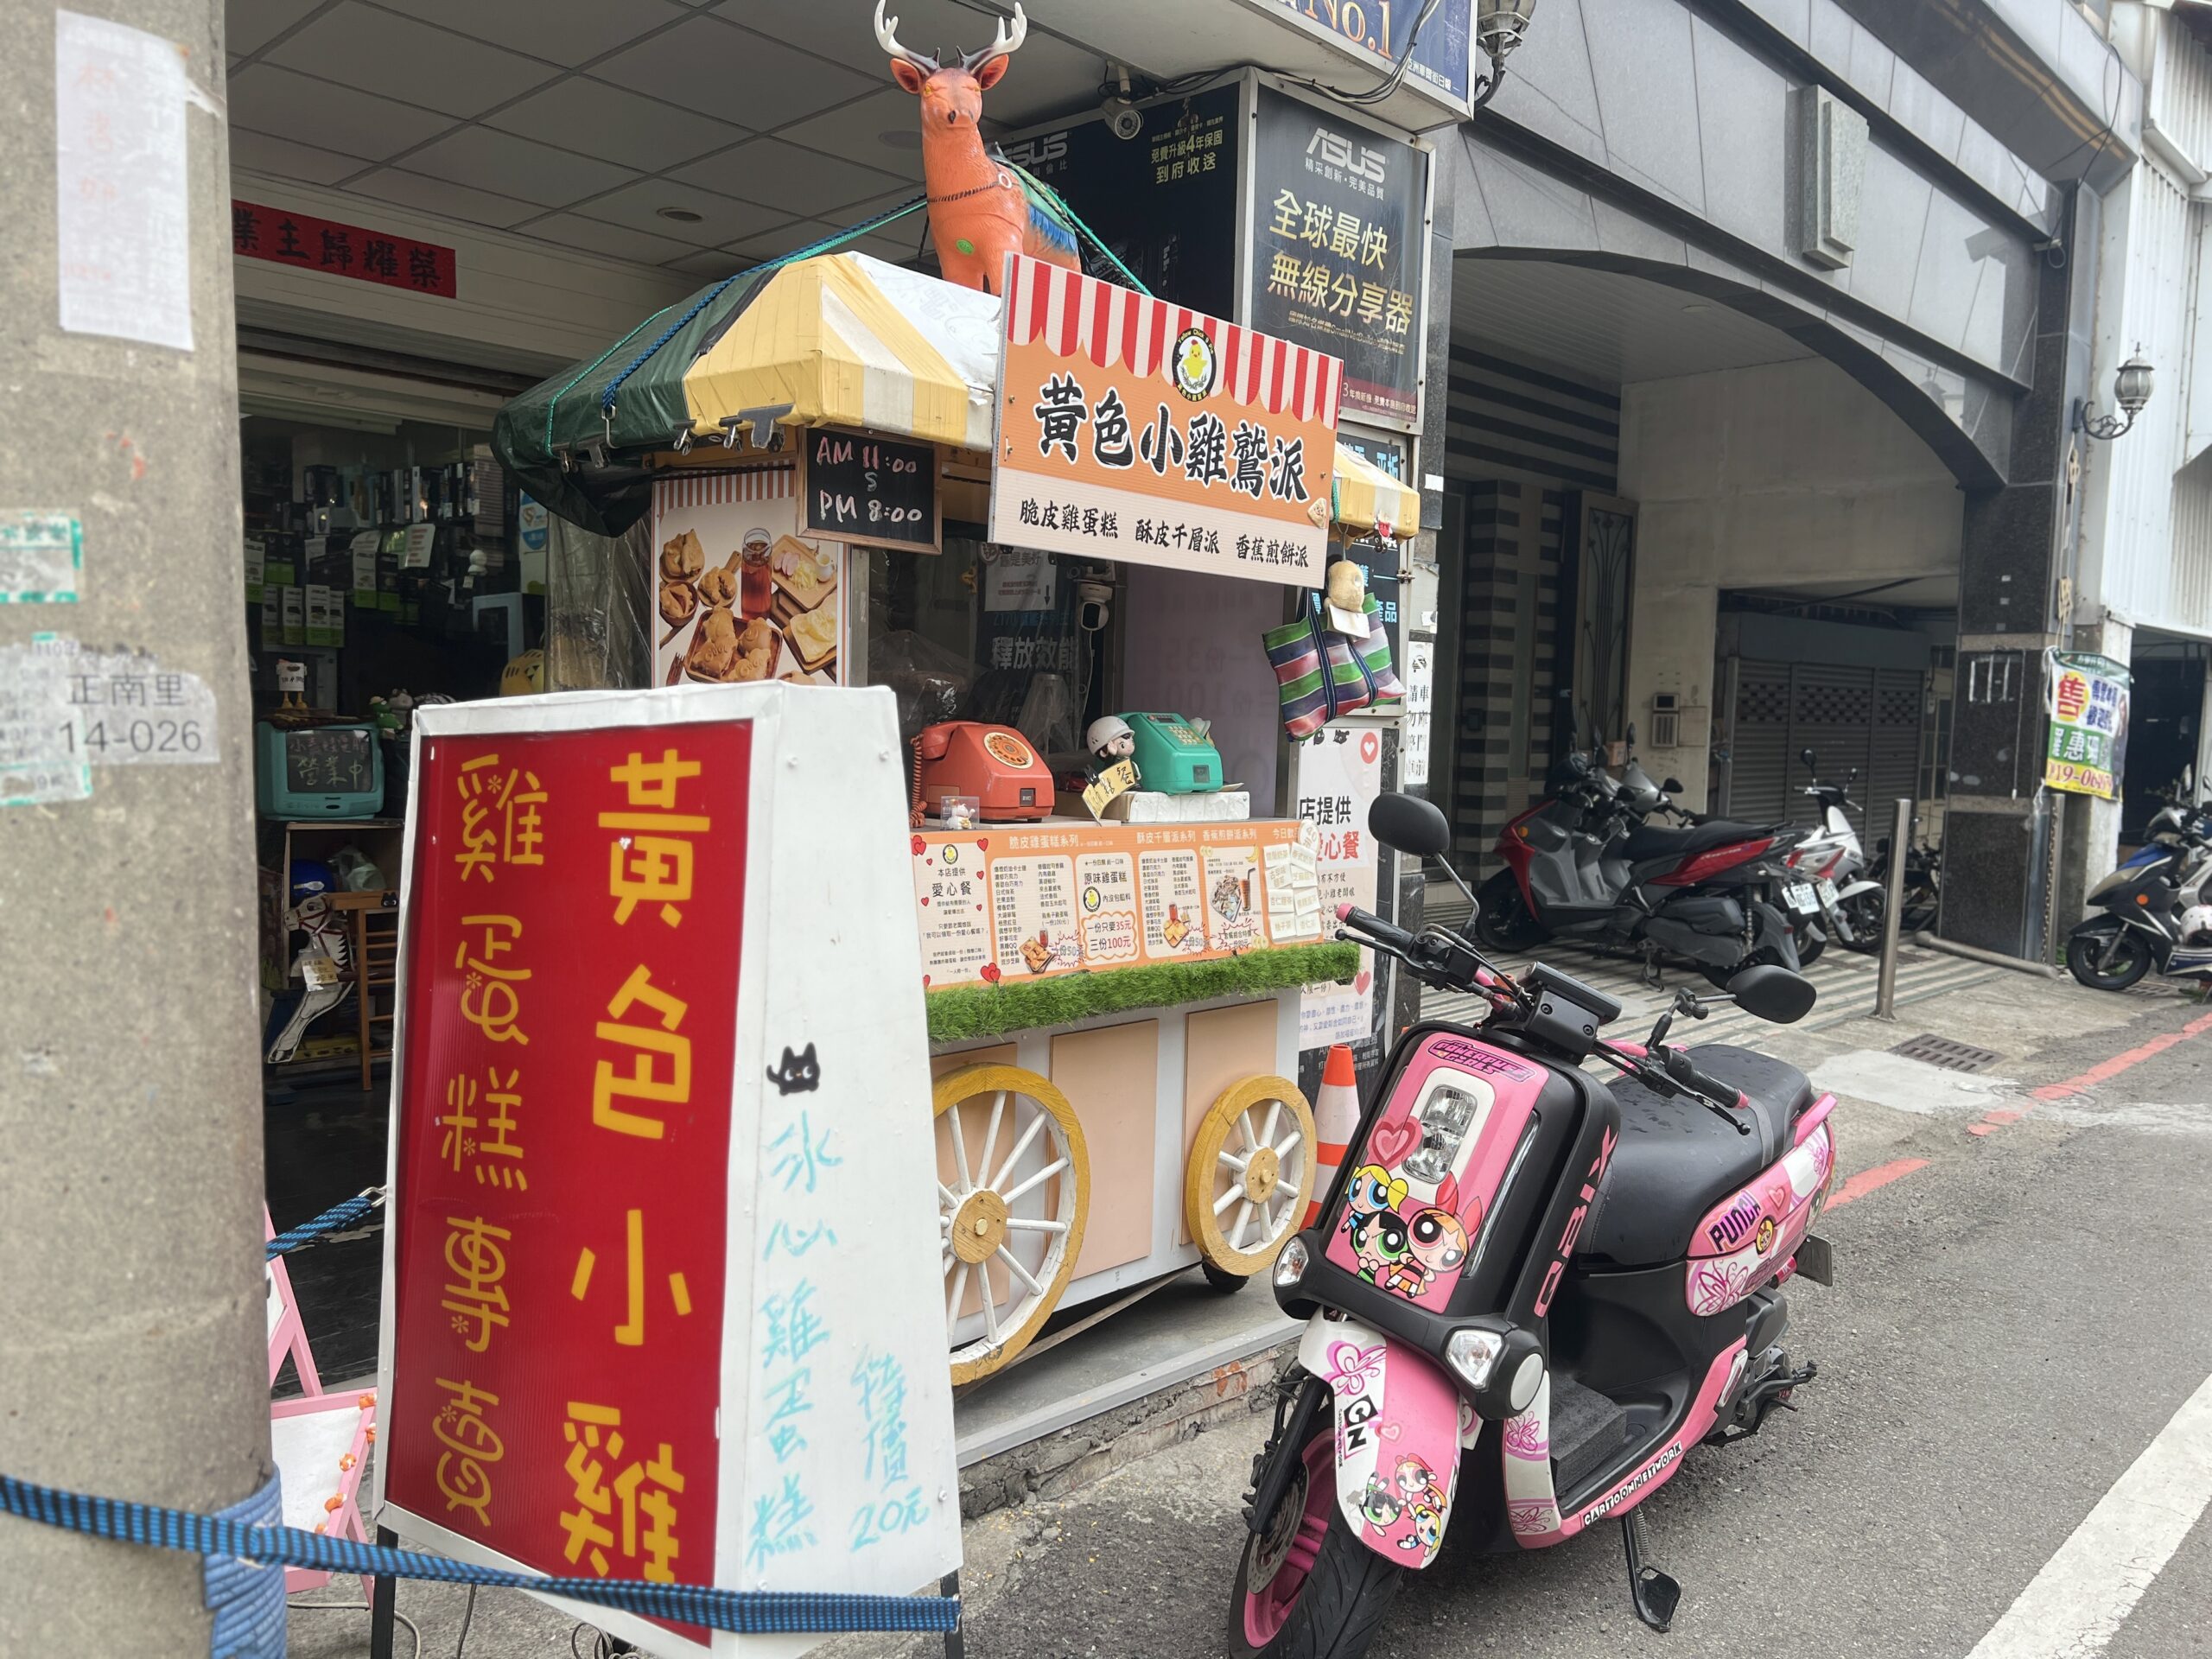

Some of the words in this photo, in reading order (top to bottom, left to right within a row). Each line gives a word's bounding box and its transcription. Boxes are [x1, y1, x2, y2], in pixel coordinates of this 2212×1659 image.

[1003, 131, 1068, 168] SUS
[1151, 129, 1224, 164] 免費升級4年保固
[1306, 127, 1386, 184] ASUS
[1155, 151, 1217, 185] 到府收送
[1268, 188, 1389, 270] 全球最快
[1267, 250, 1414, 336] 無線分享器
[817, 435, 855, 467] AM
[862, 444, 918, 474] 11:00
[1036, 373, 1309, 502] 黃色小雞鷲派
[819, 489, 858, 524] PM
[868, 499, 923, 523] 8:00
[1020, 498, 1119, 539] 脆皮雞蛋糕
[1135, 518, 1221, 555] 酥皮千層派
[1235, 533, 1310, 569] 香蕉煎餅派
[992, 635, 1077, 671] 釋放效能
[66, 673, 187, 708] 正南里
[58, 719, 203, 754] 14-026
[1008, 834, 1079, 849] 脆皮雞蛋糕系列
[1135, 830, 1196, 844] 酥皮千層派系列
[1202, 828, 1257, 842] 香蕉煎餅派系列
[931, 881, 972, 898] 愛心餐
[938, 868, 966, 878] 本店提供
[1084, 870, 1128, 886] 原味雞蛋糕
[1318, 873, 1346, 886] 有不方便
[1087, 919, 1132, 934] 一份只要35元
[1090, 936, 1132, 951] 三份100元
[558, 748, 711, 1584] 黃色小雞
[1708, 1190, 1761, 1252] PUNCH
[850, 1344, 910, 1493] 特價
[1346, 1398, 1374, 1453] CN
[849, 1486, 931, 1554] 20元
